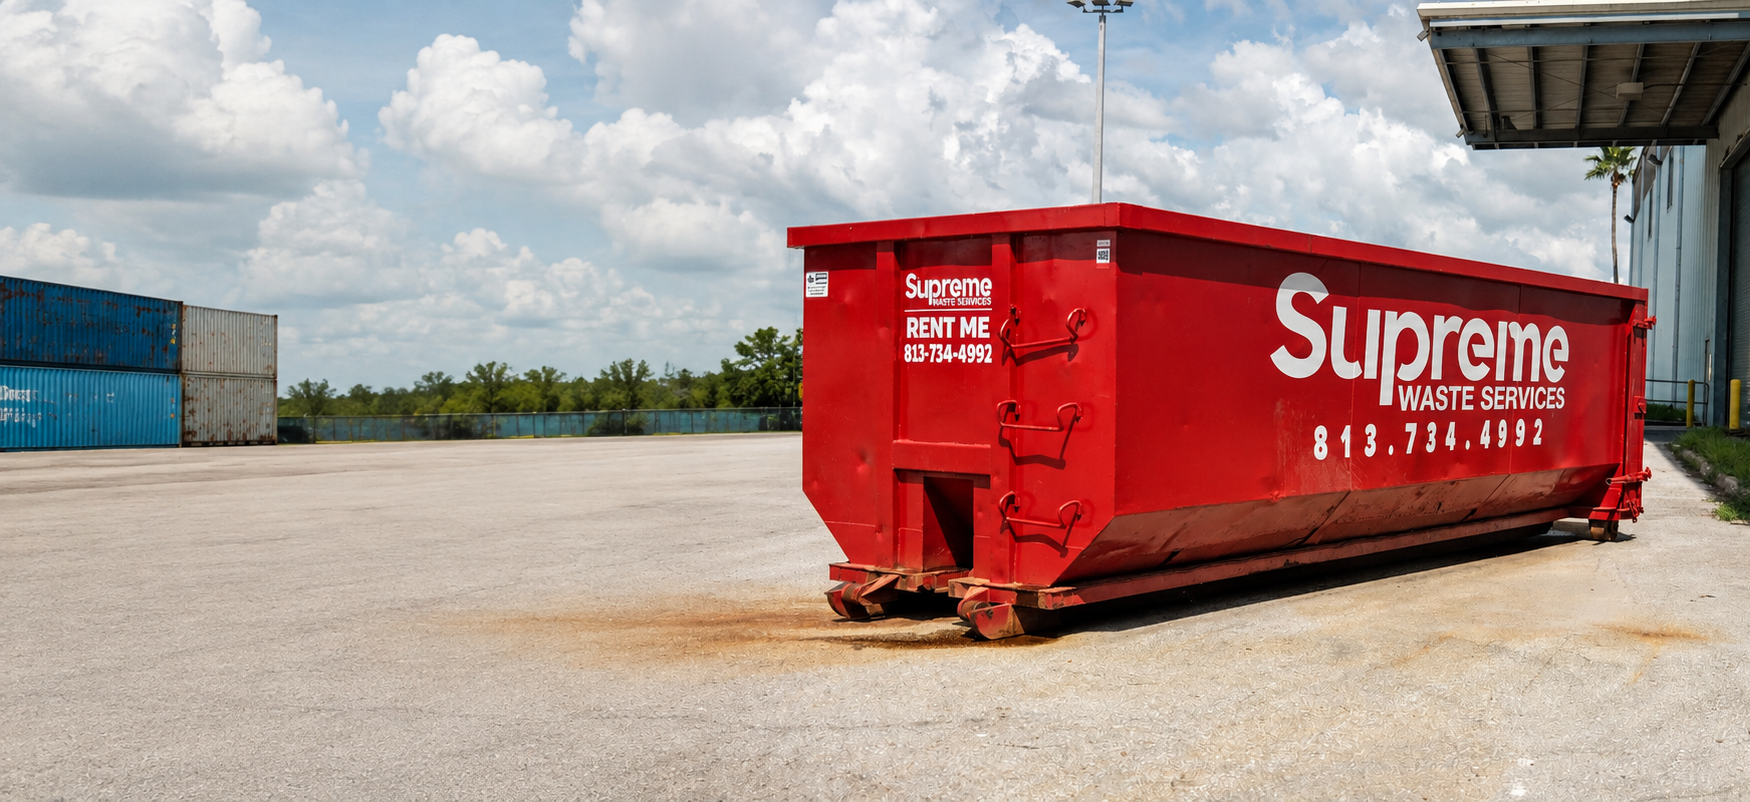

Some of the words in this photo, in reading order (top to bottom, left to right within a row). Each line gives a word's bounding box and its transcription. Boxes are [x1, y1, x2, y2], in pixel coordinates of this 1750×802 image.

[905, 273, 993, 306] Supreme
[906, 317, 955, 339] RENT
[960, 316, 991, 338] ME
[1270, 272, 1570, 406] Supreme
[904, 344, 993, 363] 813-734-4992
[1398, 385, 1475, 412] WASTE
[1480, 386, 1566, 411] SERVICES
[1313, 418, 1543, 461] 813.734.4992
